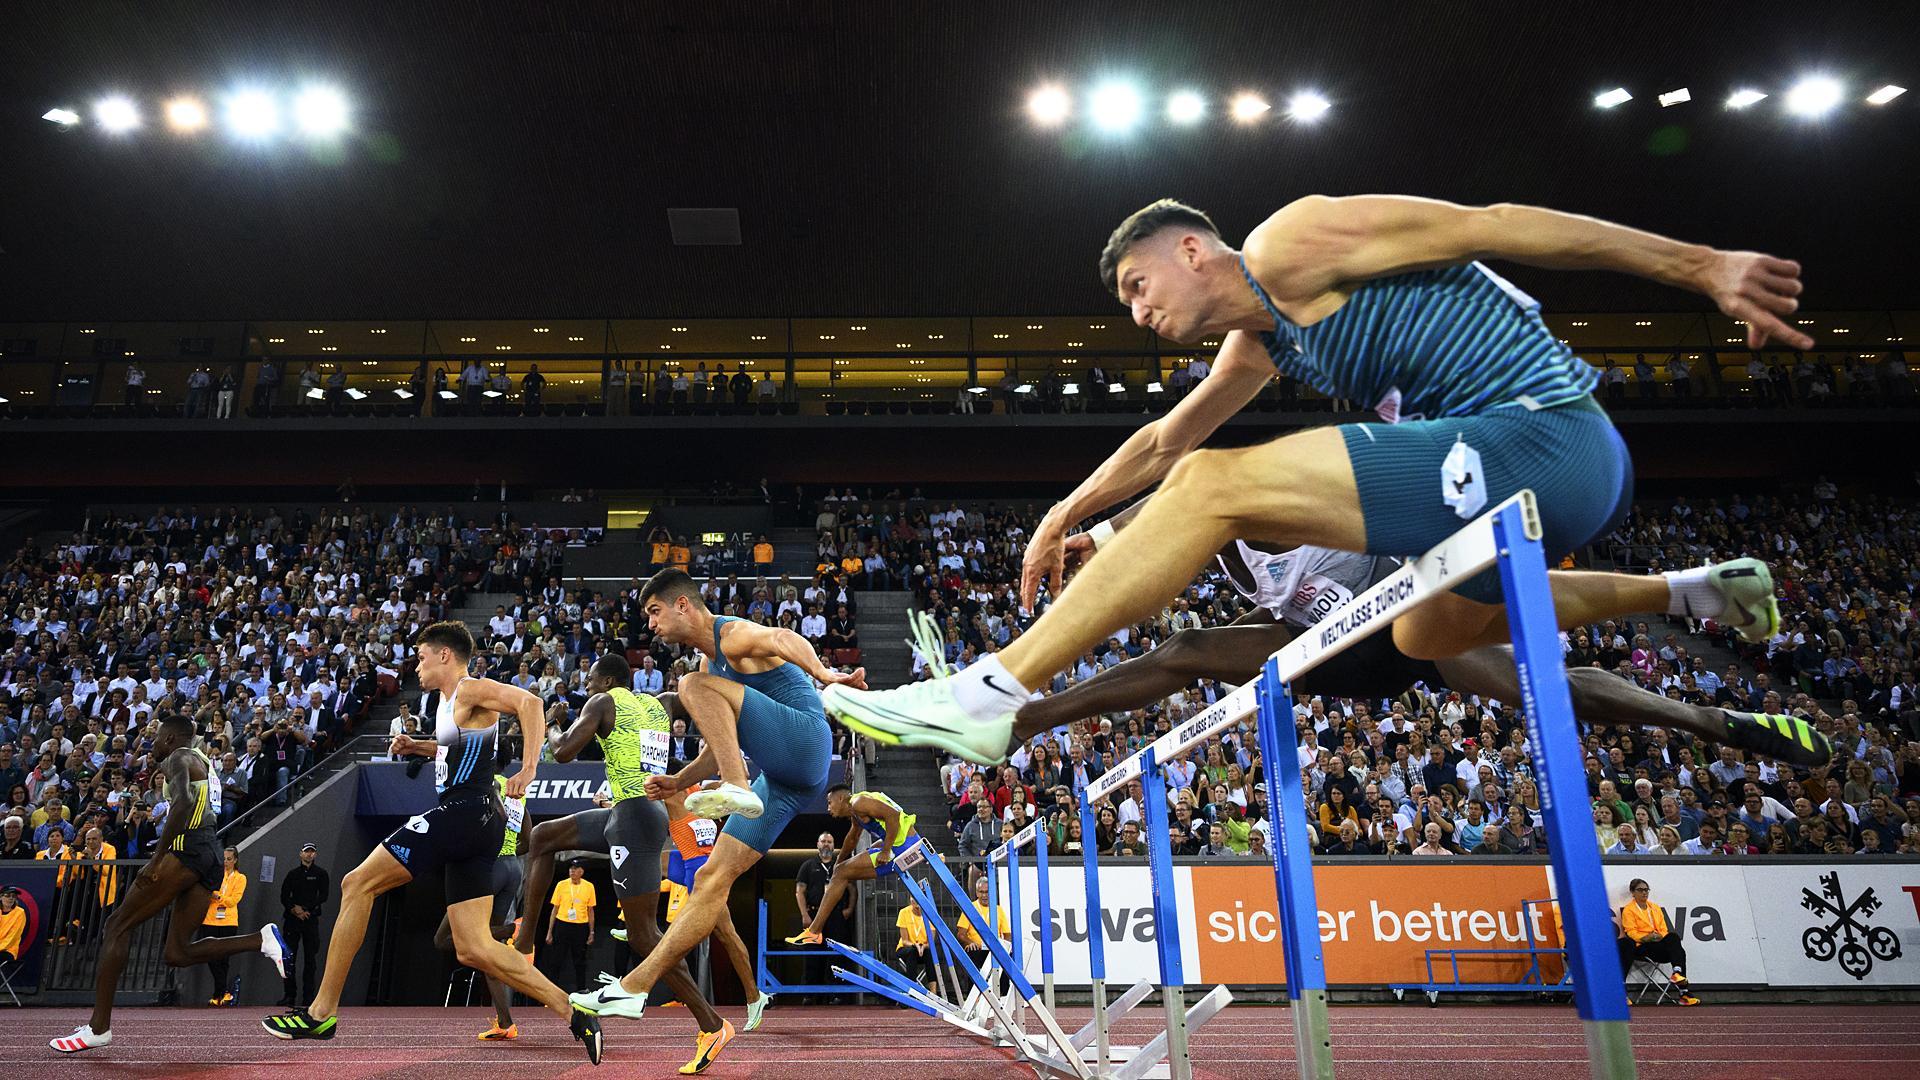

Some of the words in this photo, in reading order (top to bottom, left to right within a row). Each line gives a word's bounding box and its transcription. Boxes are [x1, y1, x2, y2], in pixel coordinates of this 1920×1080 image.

[1319, 601, 1373, 649] WELTKLASSE
[1375, 574, 1415, 616] ZÜRICH
[657, 732, 670, 744] UB
[1179, 717, 1207, 745] WELTKLASSE
[412, 821, 422, 831] 4
[615, 849, 621, 860] 5
[1030, 907, 1160, 943] suva
[1208, 900, 1356, 943] sicer
[1369, 900, 1547, 943] betreut
